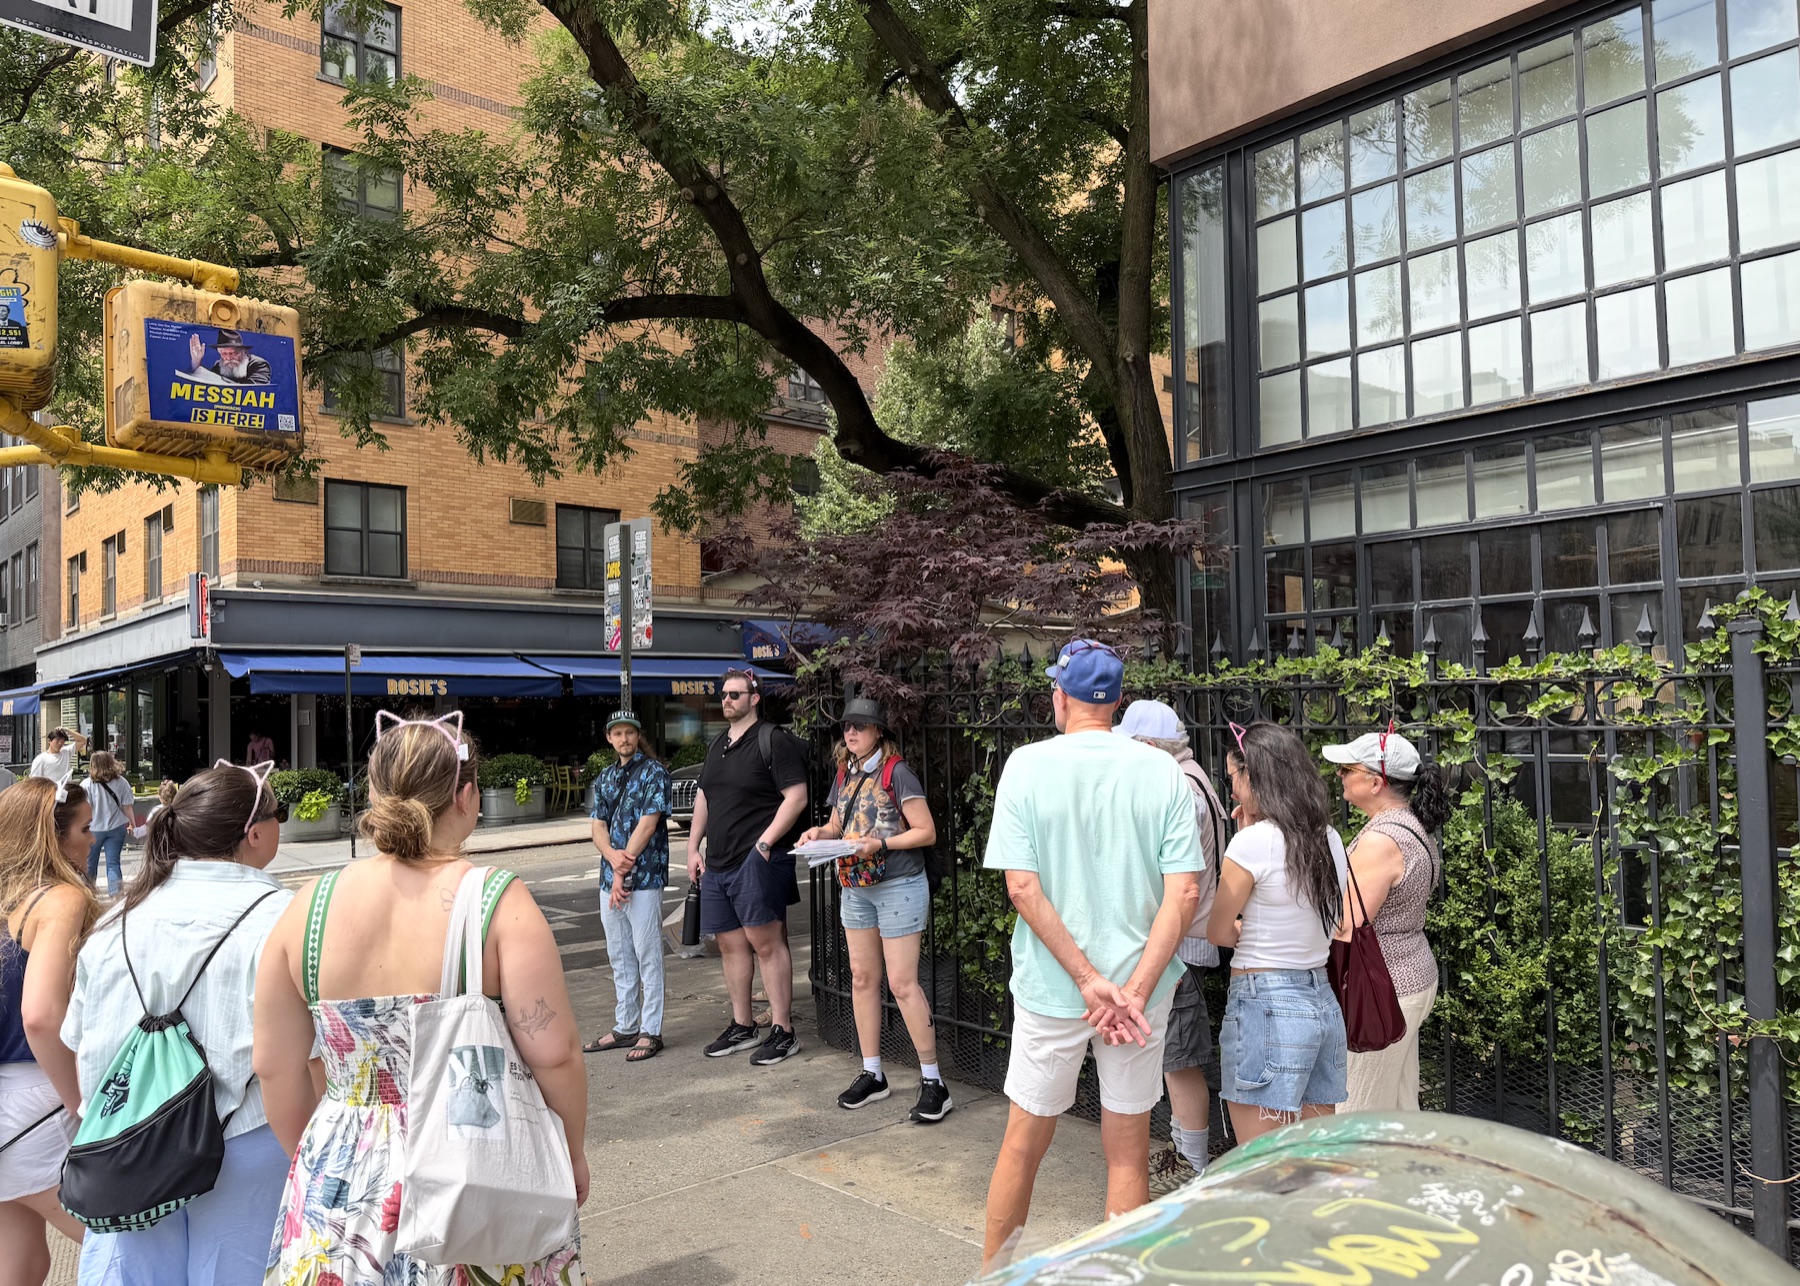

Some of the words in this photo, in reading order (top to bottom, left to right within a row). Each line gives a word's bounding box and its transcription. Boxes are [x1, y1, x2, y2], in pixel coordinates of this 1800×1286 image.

[15, 17, 40, 28] DEPT
[45, 26, 58, 34] OF
[62, 31, 144, 60] TRANSPORTATION
[171, 382, 275, 409] MESSIAH
[193, 409, 209, 423] IS
[214, 411, 264, 427] HERE!
[387, 678, 448, 696] ROSIE'S
[671, 681, 715, 695] ROSIE'S
